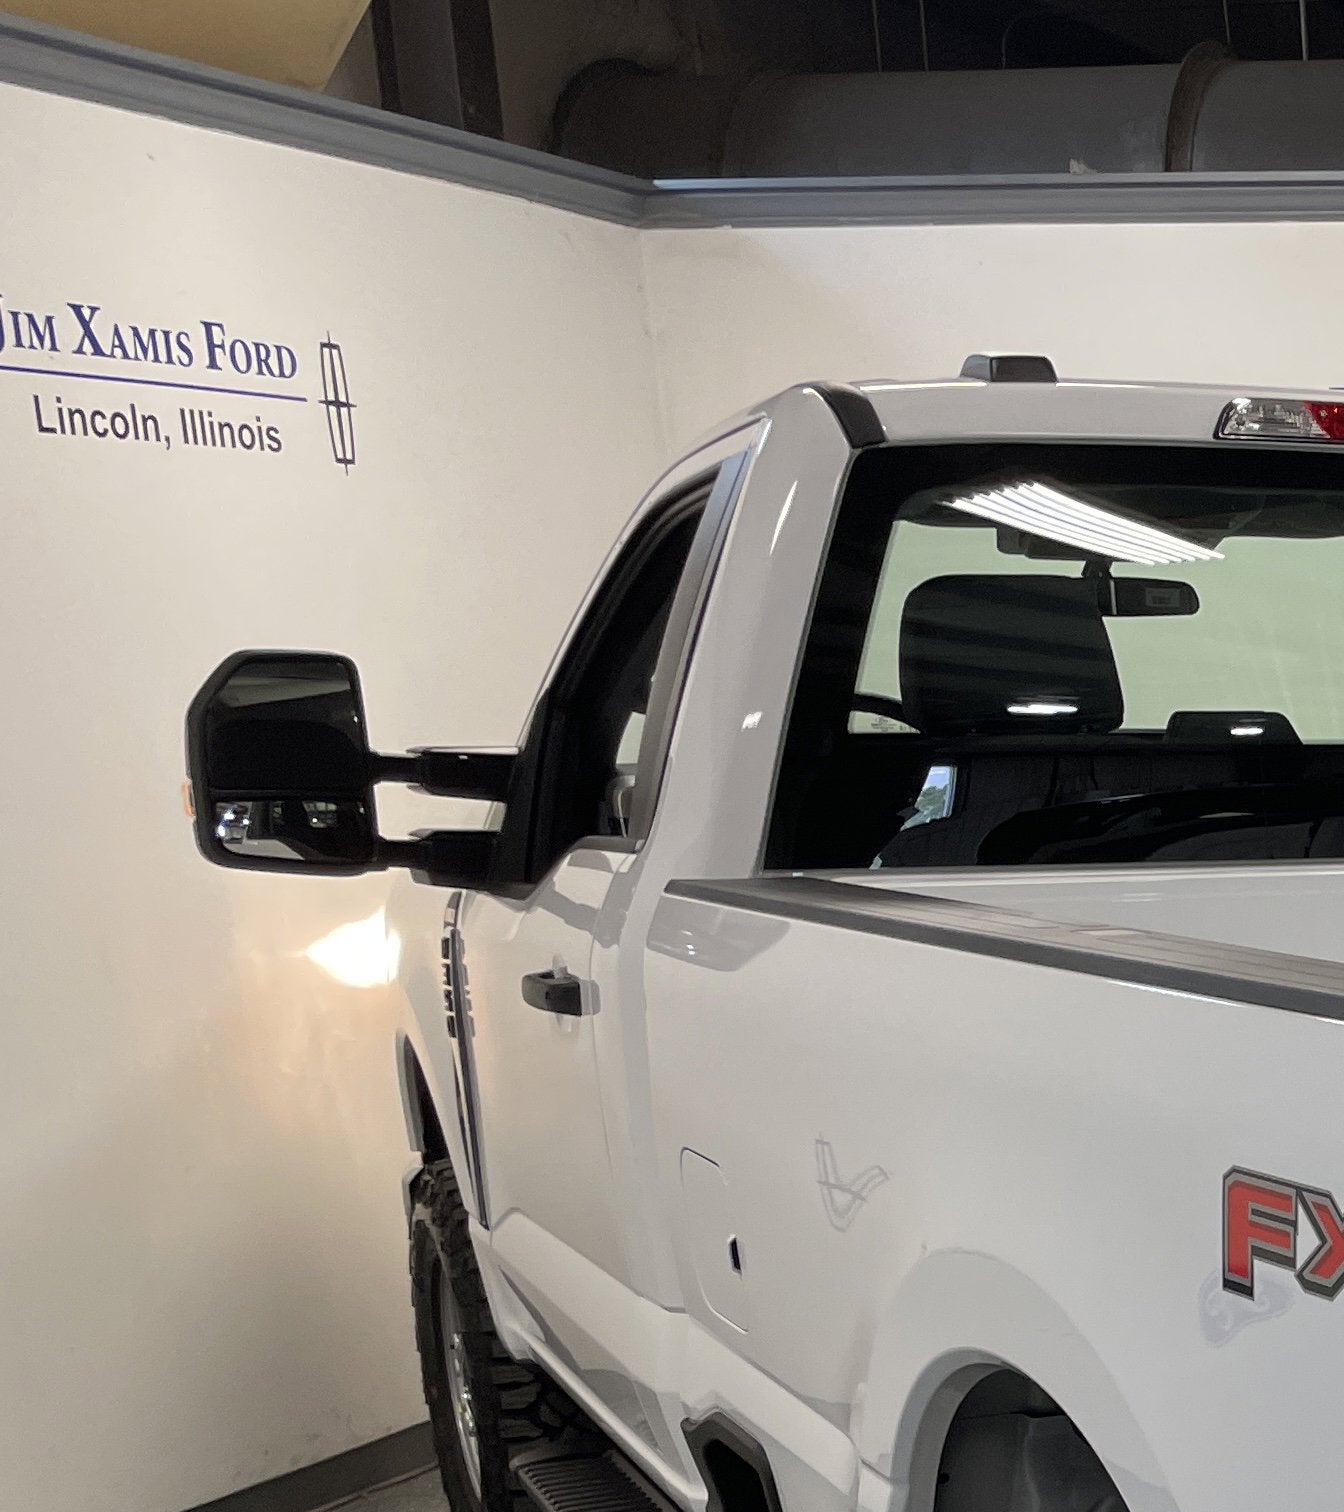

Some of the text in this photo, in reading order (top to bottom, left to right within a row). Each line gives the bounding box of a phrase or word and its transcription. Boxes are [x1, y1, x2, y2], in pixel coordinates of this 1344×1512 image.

[0, 293, 298, 379] IM XAMIS FORD
[33, 394, 283, 452] Lincoln, Illinois
